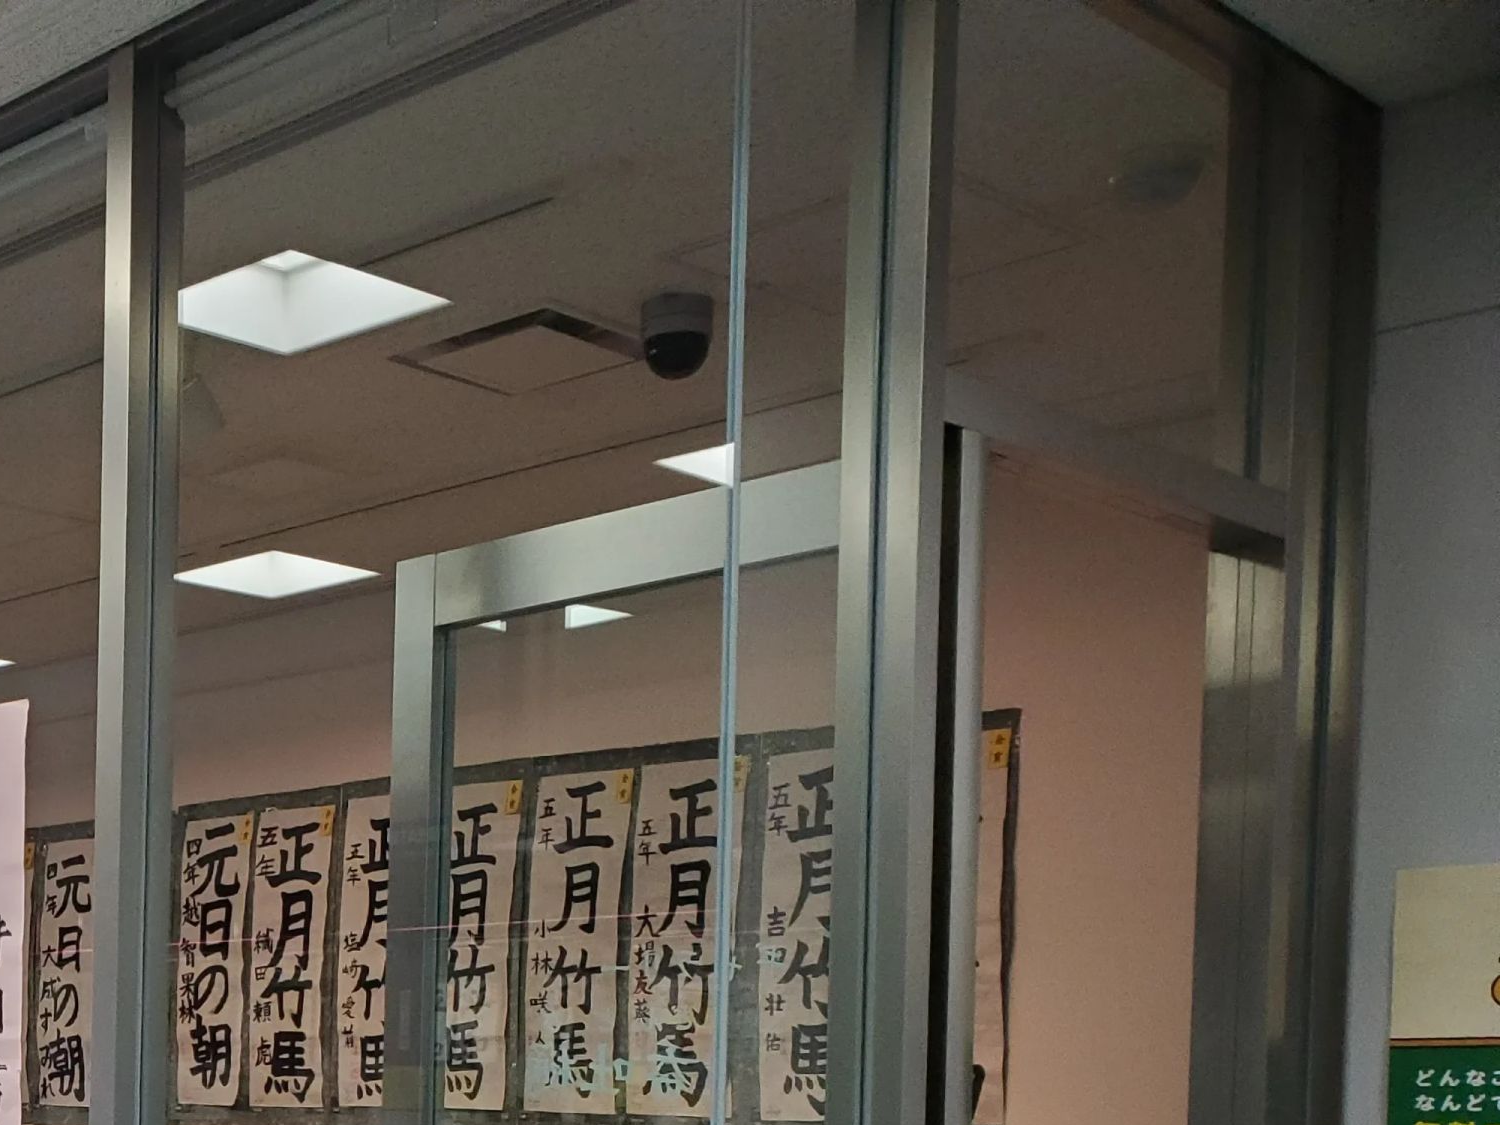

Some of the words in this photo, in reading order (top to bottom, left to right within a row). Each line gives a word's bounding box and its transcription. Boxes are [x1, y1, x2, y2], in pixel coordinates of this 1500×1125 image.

[49, 854, 91, 1103] 元日の朝
[190, 821, 241, 1090] 元日の朝
[260, 822, 323, 1104] 正月竹馬
[446, 802, 499, 1101] 正月竹馬
[543, 780, 615, 1099] 正月竹馬
[641, 778, 718, 1109] 正月竹馬
